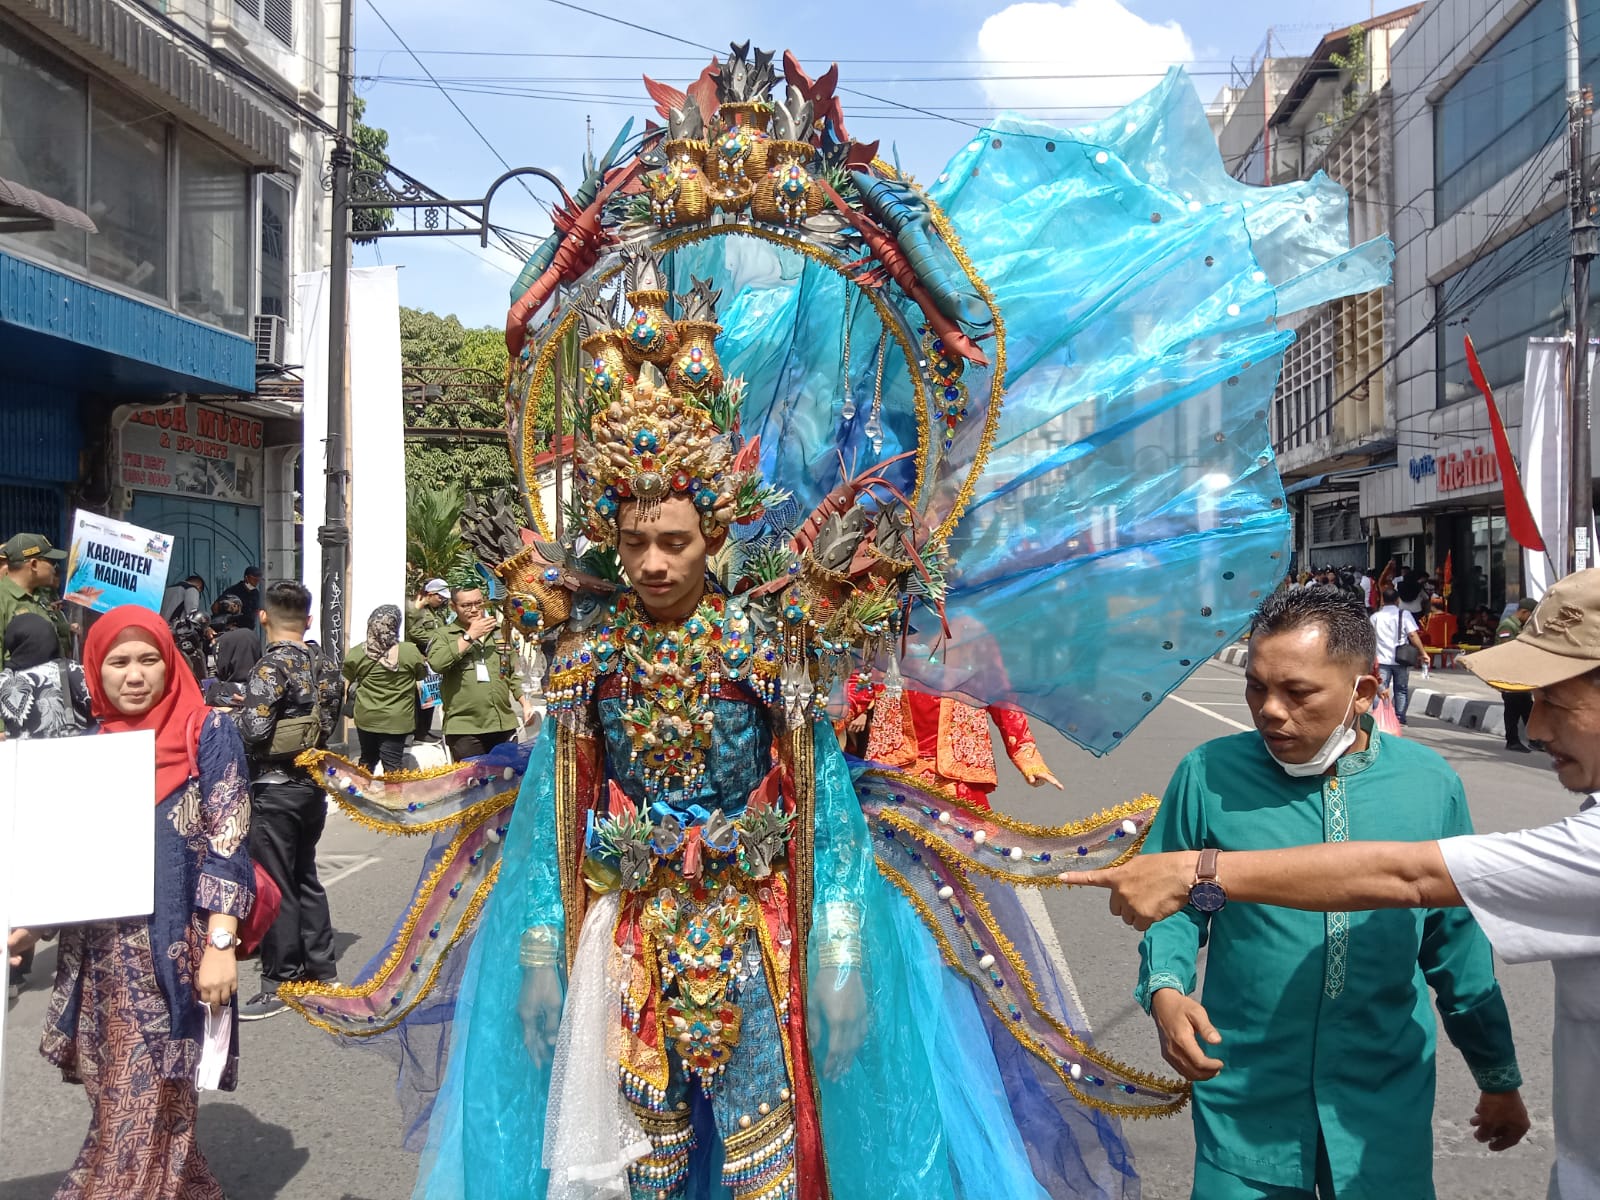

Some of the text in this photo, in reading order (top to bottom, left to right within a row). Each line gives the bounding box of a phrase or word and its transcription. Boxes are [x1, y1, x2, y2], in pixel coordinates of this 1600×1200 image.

[197, 407, 263, 449] MUSIC
[159, 432, 229, 459] & SPORTS
[86, 541, 152, 576] KABUPATEN
[94, 563, 138, 593] MADINA
